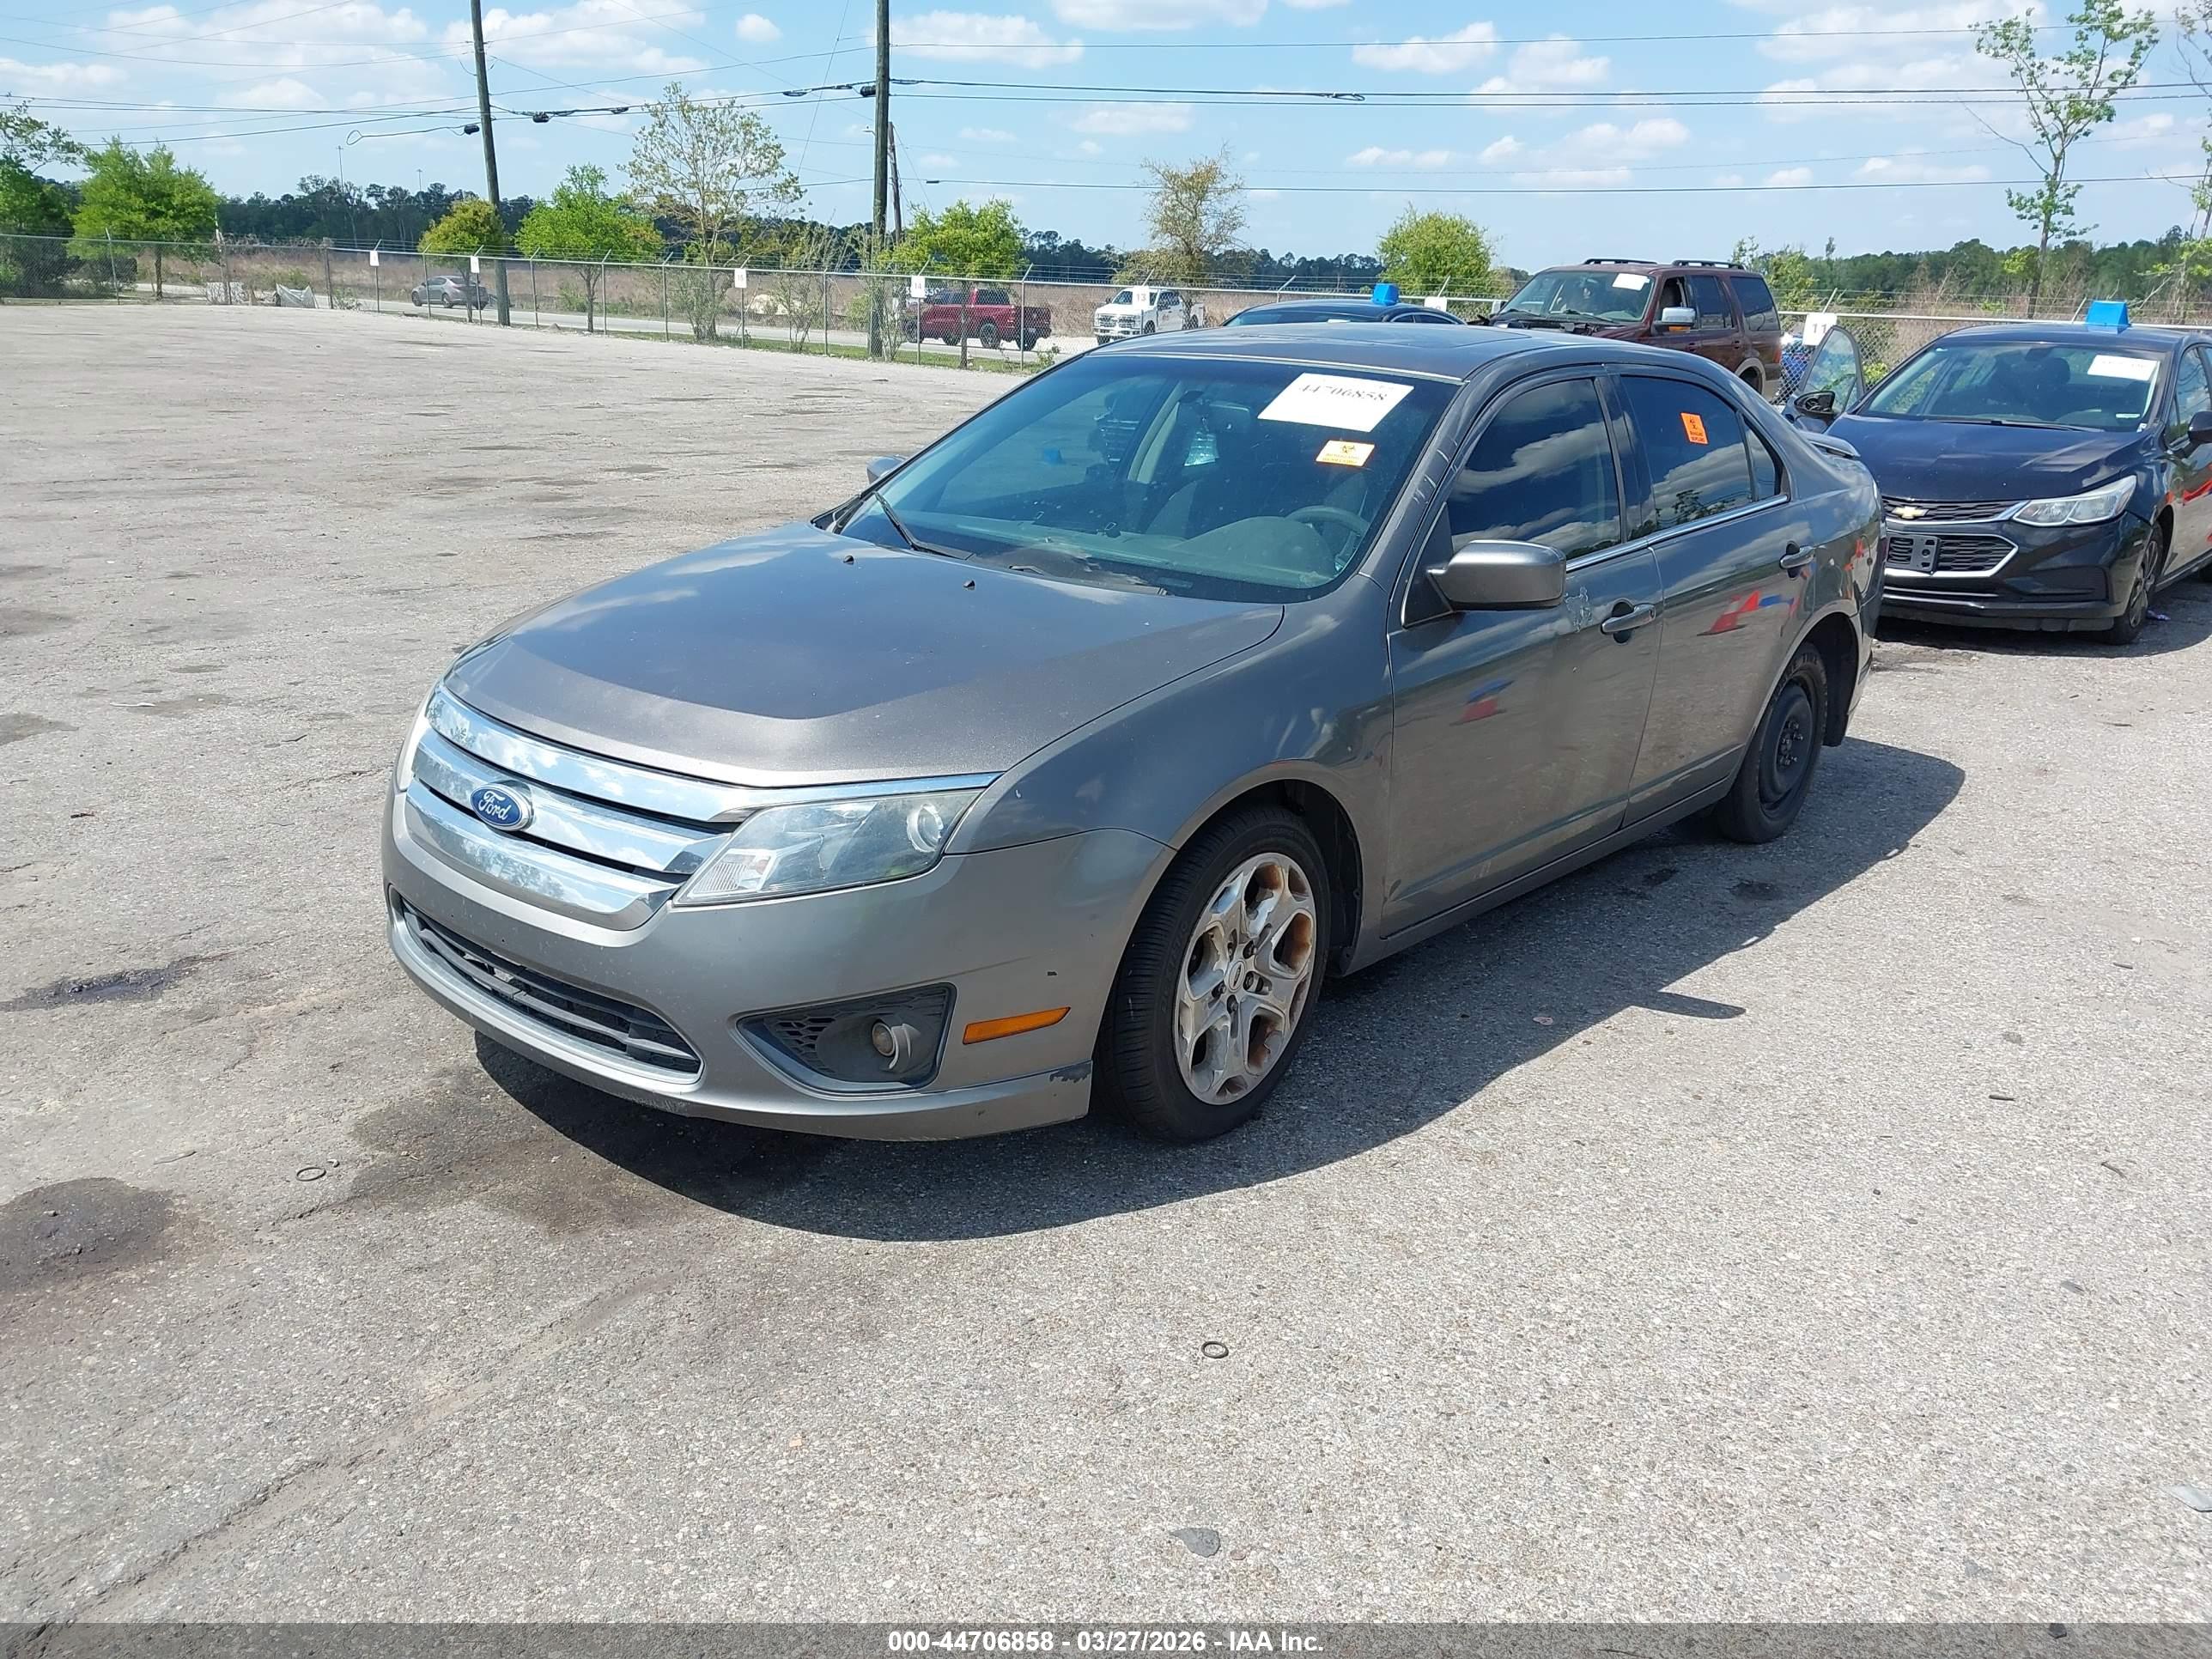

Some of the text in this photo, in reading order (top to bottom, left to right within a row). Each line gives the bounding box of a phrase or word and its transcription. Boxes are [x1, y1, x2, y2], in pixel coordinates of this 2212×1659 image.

[1136, 293, 1147, 302] 13
[1813, 323, 1827, 334] 11
[1299, 384, 1388, 401] 44706858
[478, 790, 512, 820] Ford
